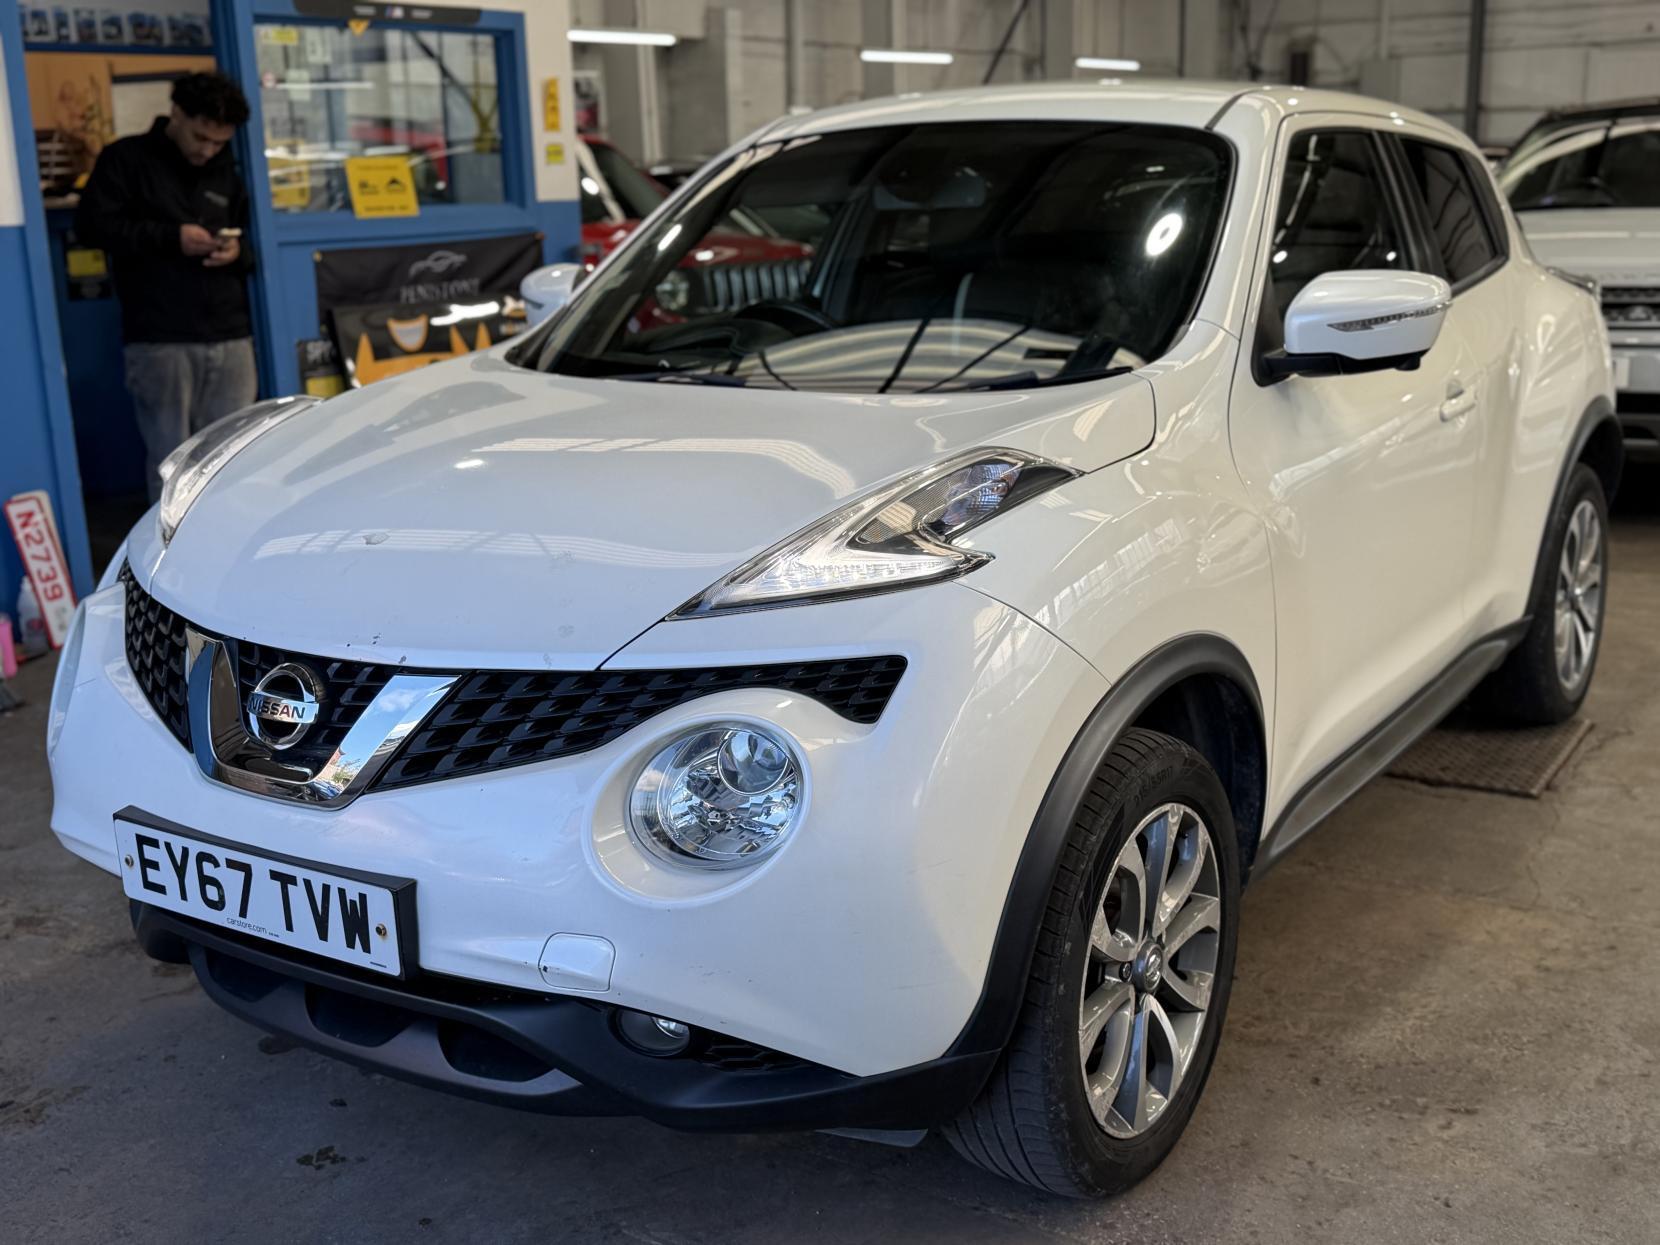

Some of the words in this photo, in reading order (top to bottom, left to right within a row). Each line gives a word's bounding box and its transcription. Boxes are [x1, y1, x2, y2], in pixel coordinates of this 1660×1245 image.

[16, 508, 65, 602] N2739
[248, 697, 306, 719] NISSAN
[135, 833, 253, 919] EY67
[269, 869, 371, 954] TVW
[226, 917, 268, 934] carstore.com
